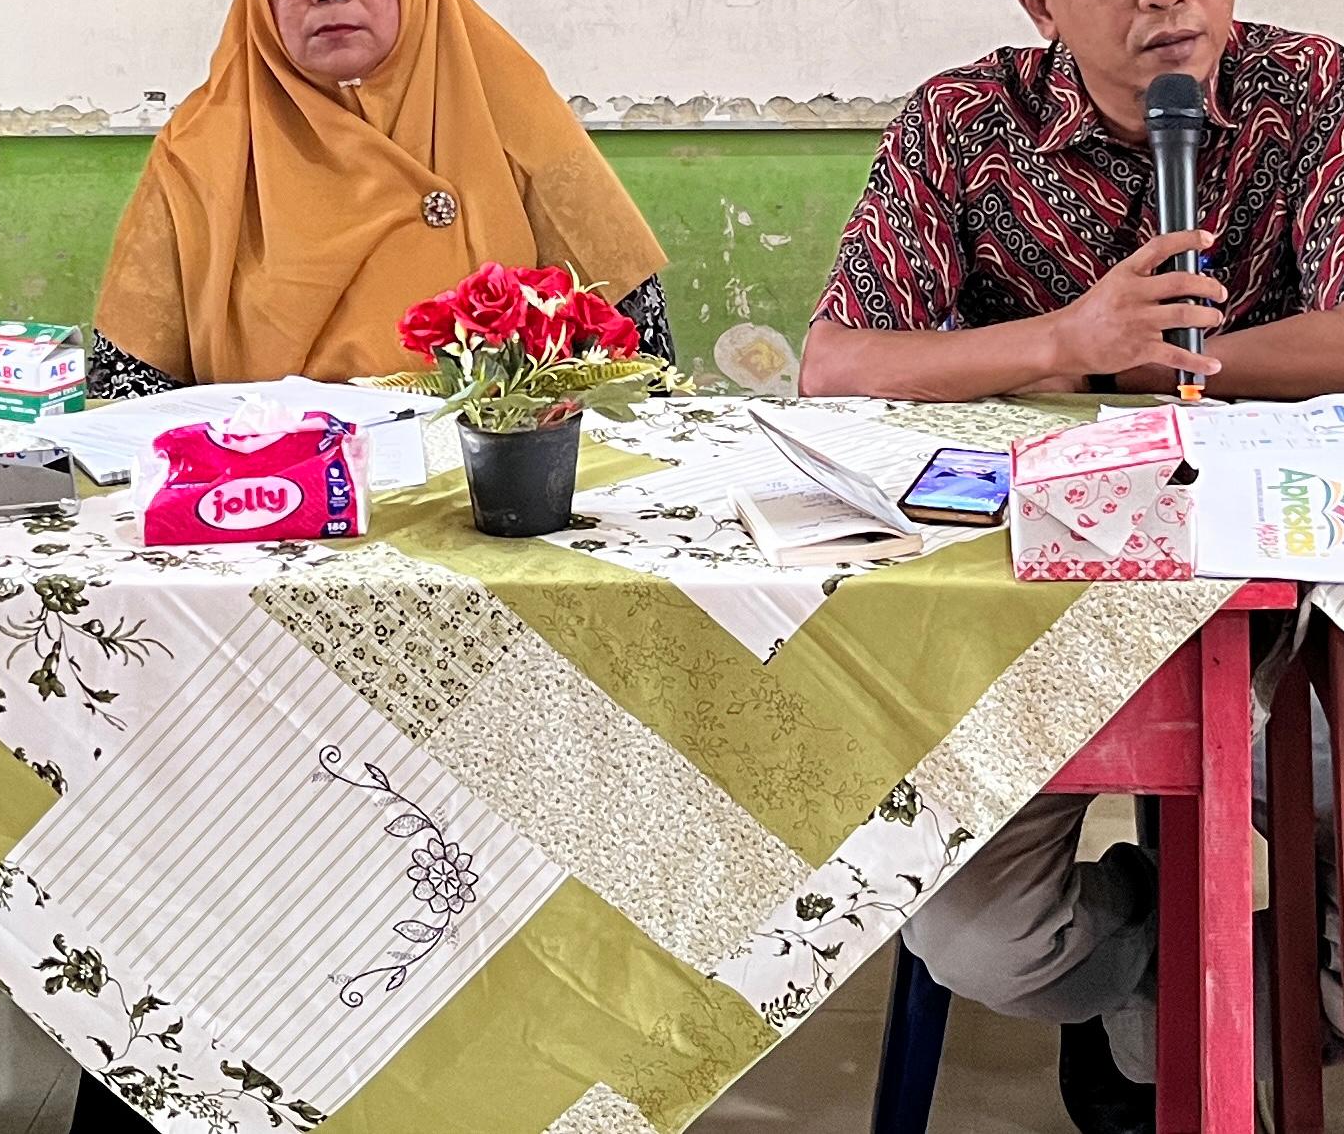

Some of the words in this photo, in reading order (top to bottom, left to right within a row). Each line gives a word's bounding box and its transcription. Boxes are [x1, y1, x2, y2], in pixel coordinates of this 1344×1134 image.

[50, 360, 76, 378] ABC
[212, 486, 288, 523] jolly
[1267, 467, 1330, 557] Apresiasi
[327, 521, 347, 532] 180
